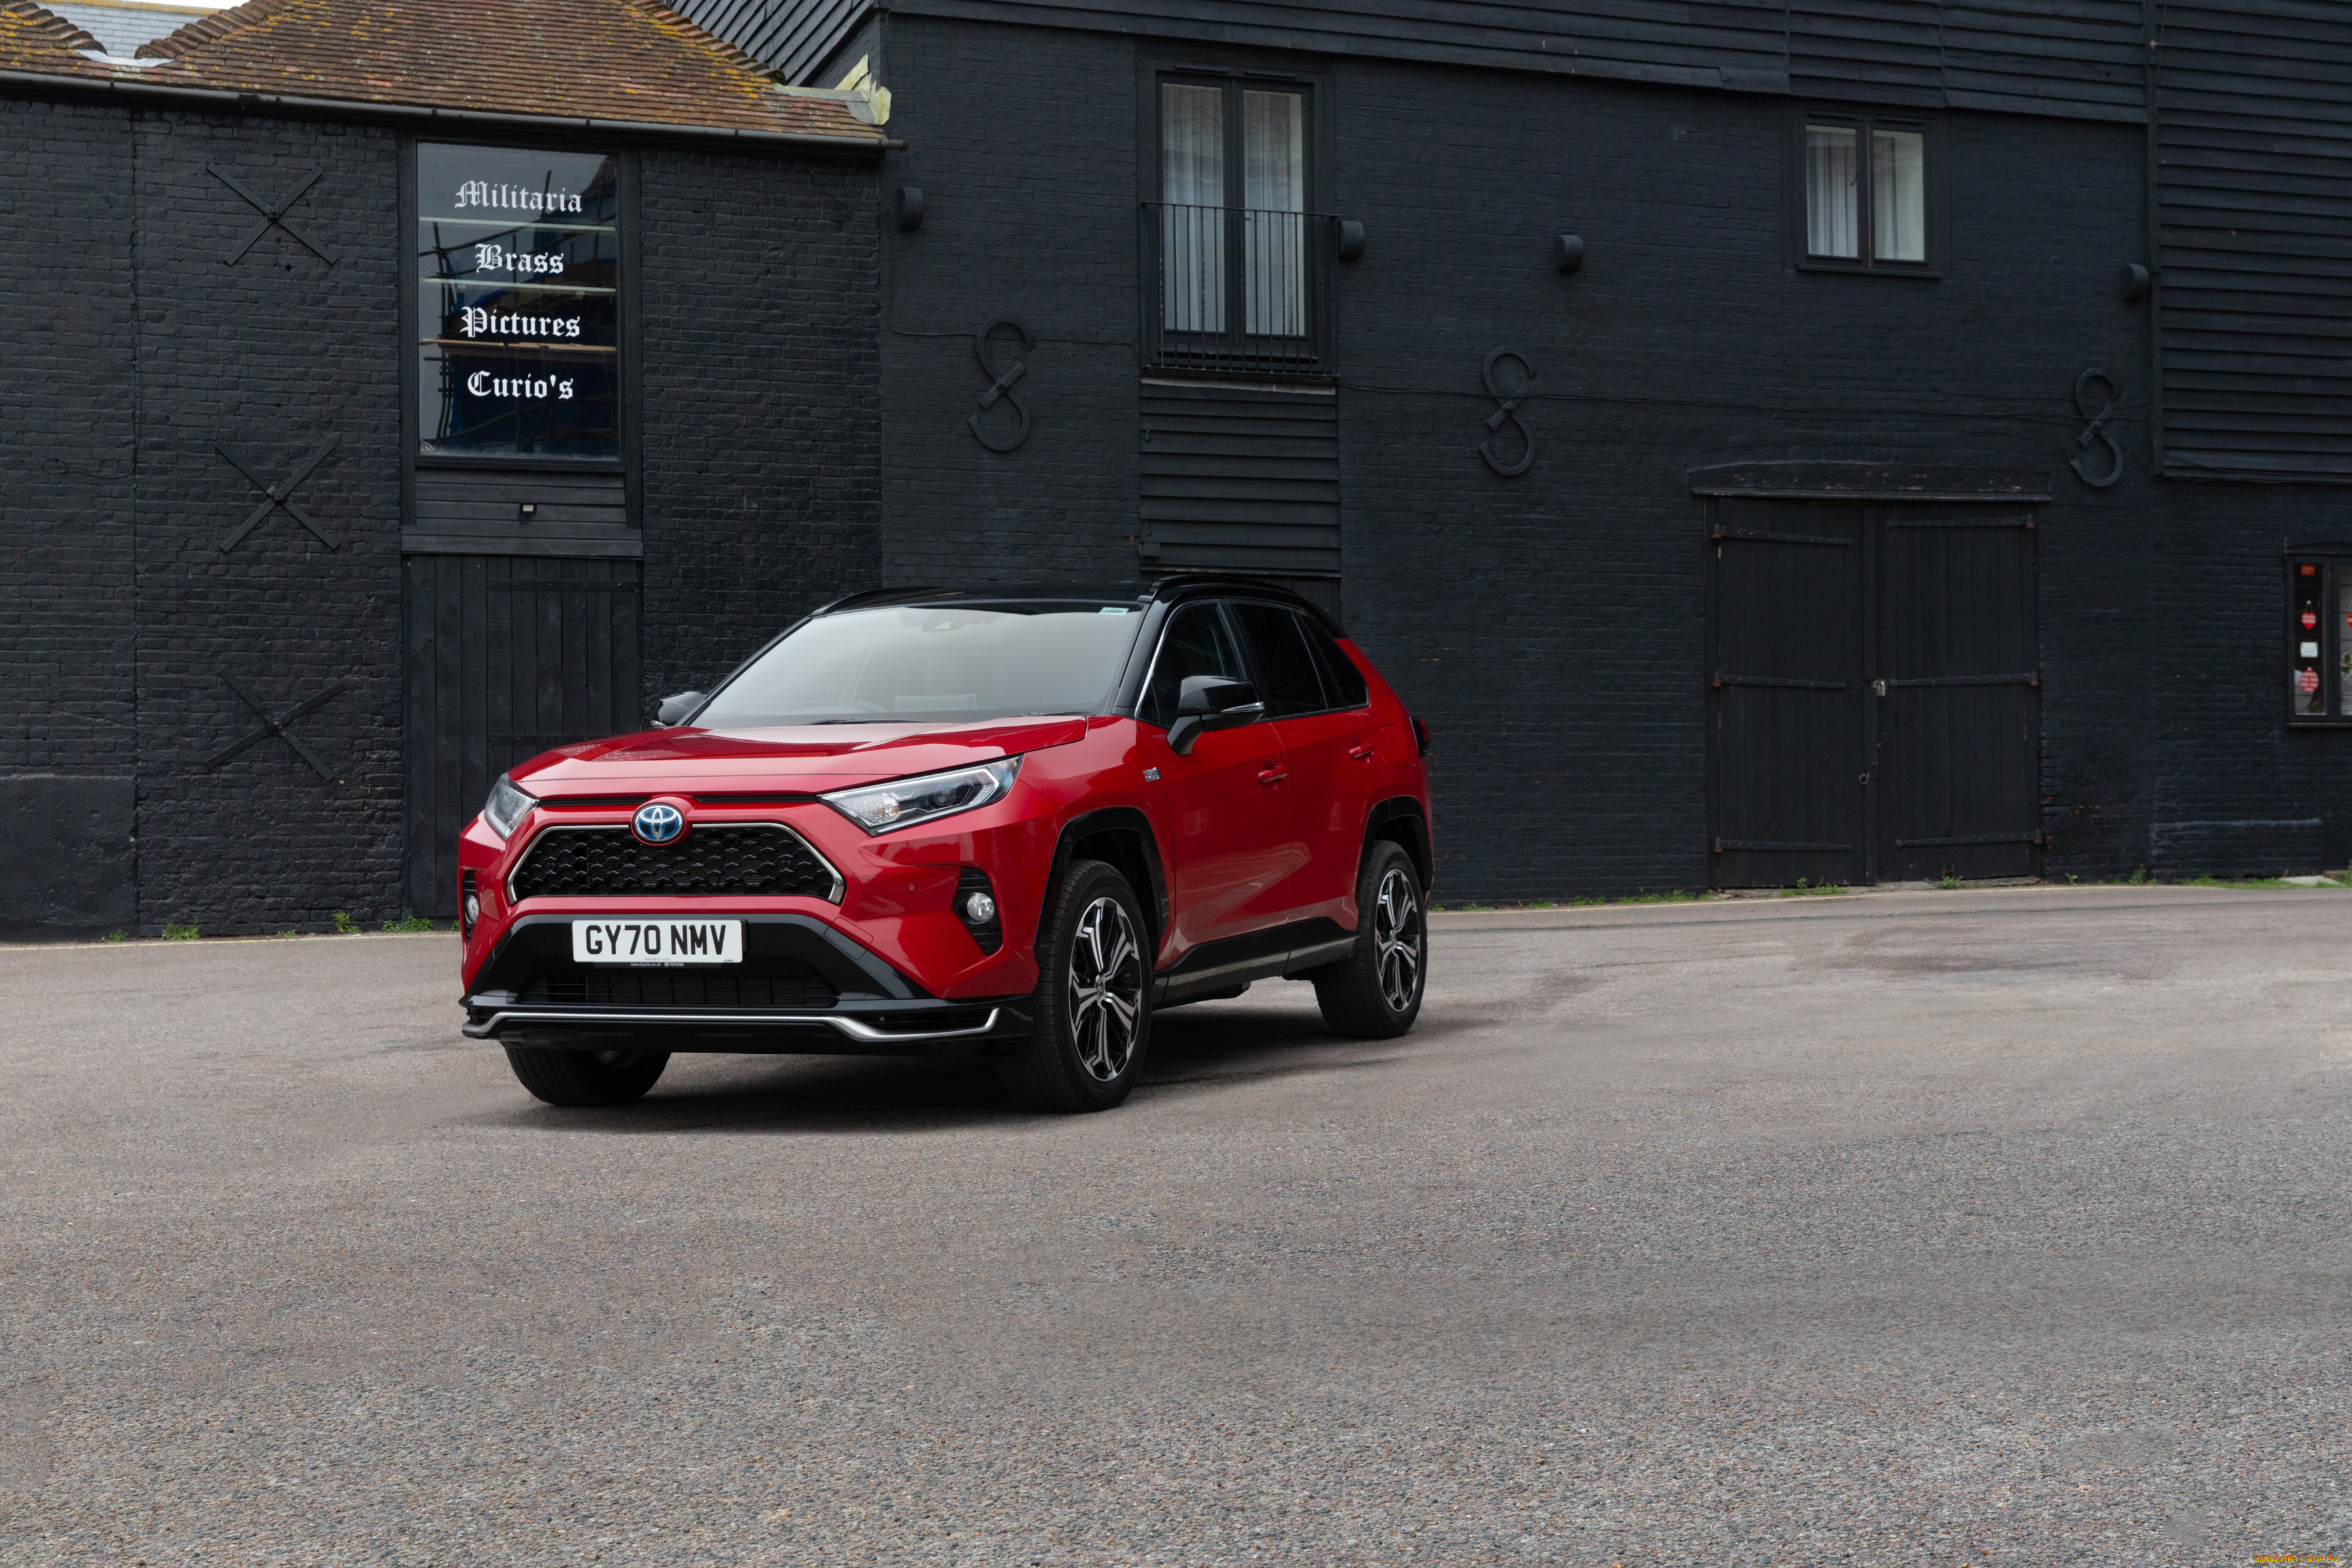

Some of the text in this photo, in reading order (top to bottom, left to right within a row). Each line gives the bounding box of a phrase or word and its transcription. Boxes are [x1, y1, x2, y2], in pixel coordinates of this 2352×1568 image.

[455, 180, 582, 212] Militaria
[475, 244, 564, 273] Brass
[460, 306, 580, 337] Pictures
[467, 370, 574, 399] Curio's
[586, 924, 726, 955] GY70 NMV
